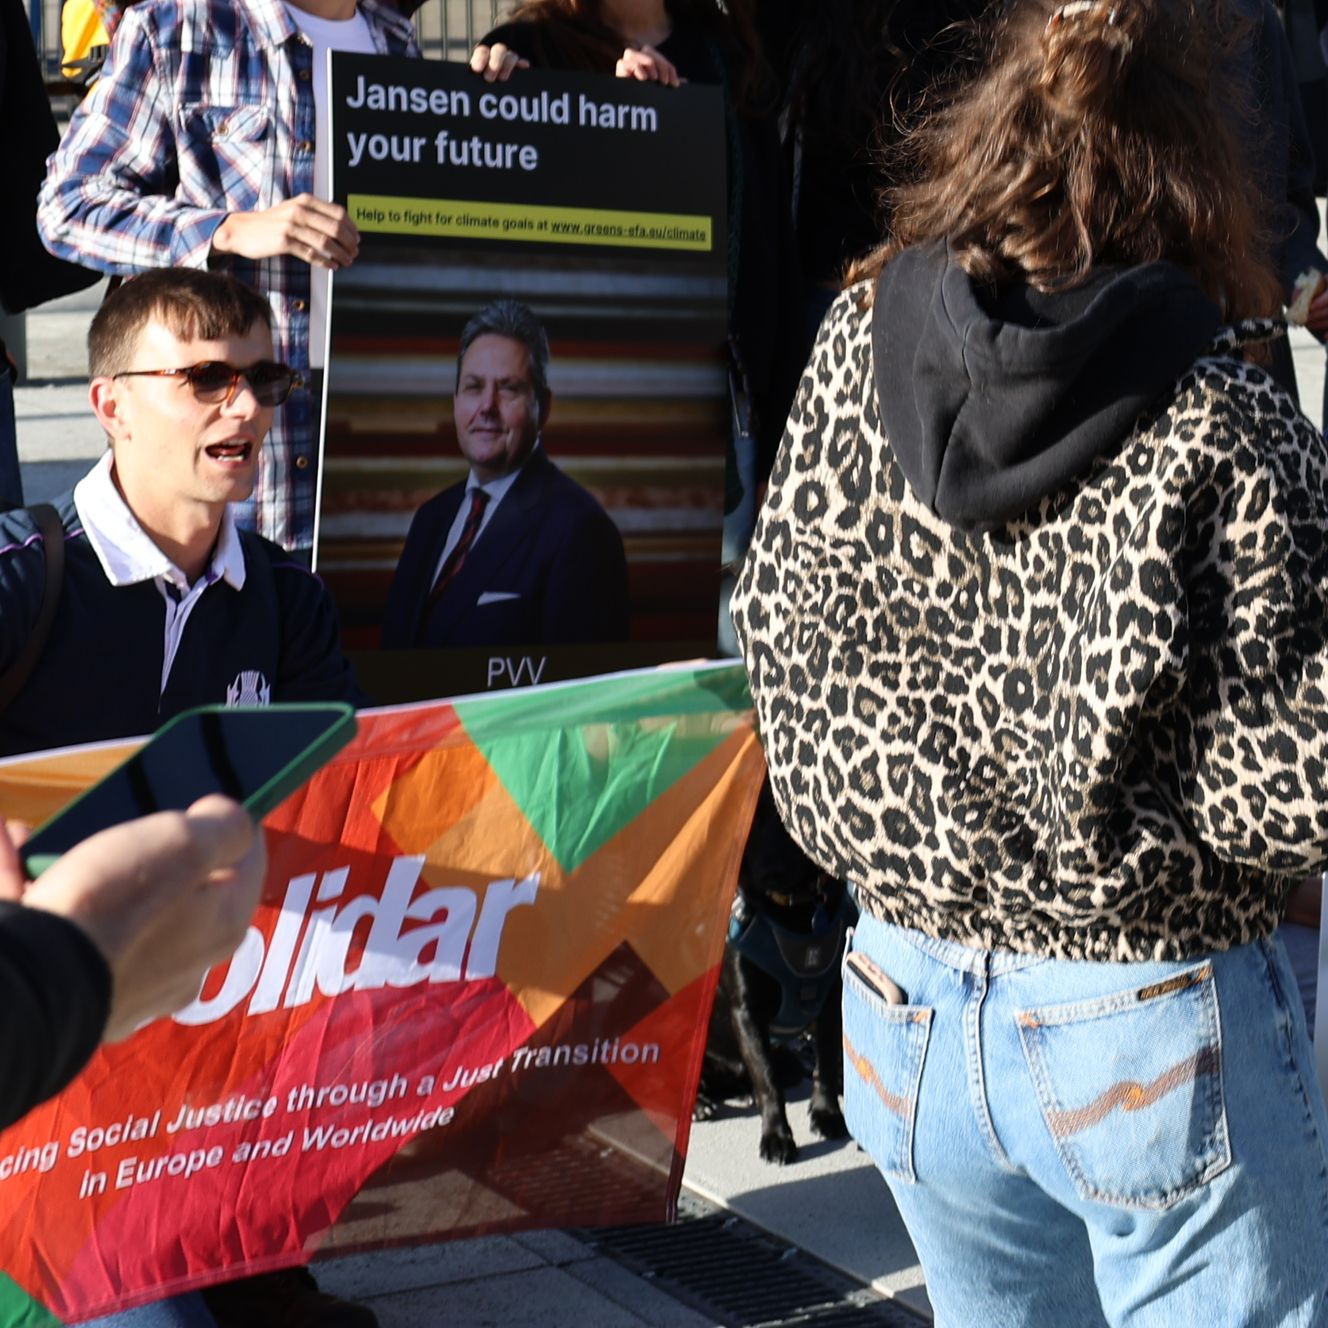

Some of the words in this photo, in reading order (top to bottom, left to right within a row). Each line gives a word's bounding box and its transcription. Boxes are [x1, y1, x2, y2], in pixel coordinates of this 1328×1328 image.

[346, 75, 470, 117] Jansen
[479, 91, 570, 125] could
[578, 94, 657, 132] harm
[356, 207, 386, 226] Help
[388, 210, 401, 223] to
[403, 209, 433, 227] fight
[435, 211, 453, 226] for
[455, 213, 500, 229] climate
[501, 217, 534, 232] goals
[536, 219, 548, 231] at
[487, 656, 554, 690] PVV
[172, 853, 541, 1027] olidar
[67, 1109, 162, 1159] Social
[167, 1095, 278, 1135] Justice
[286, 1074, 409, 1114] through
[416, 1078, 435, 1096] a
[443, 1055, 506, 1093] Just
[510, 1036, 661, 1074] Transition
[79, 1168, 107, 1200] in
[115, 1142, 226, 1190] Europe
[232, 1134, 292, 1162] and
[301, 1104, 455, 1150] Worldwide
